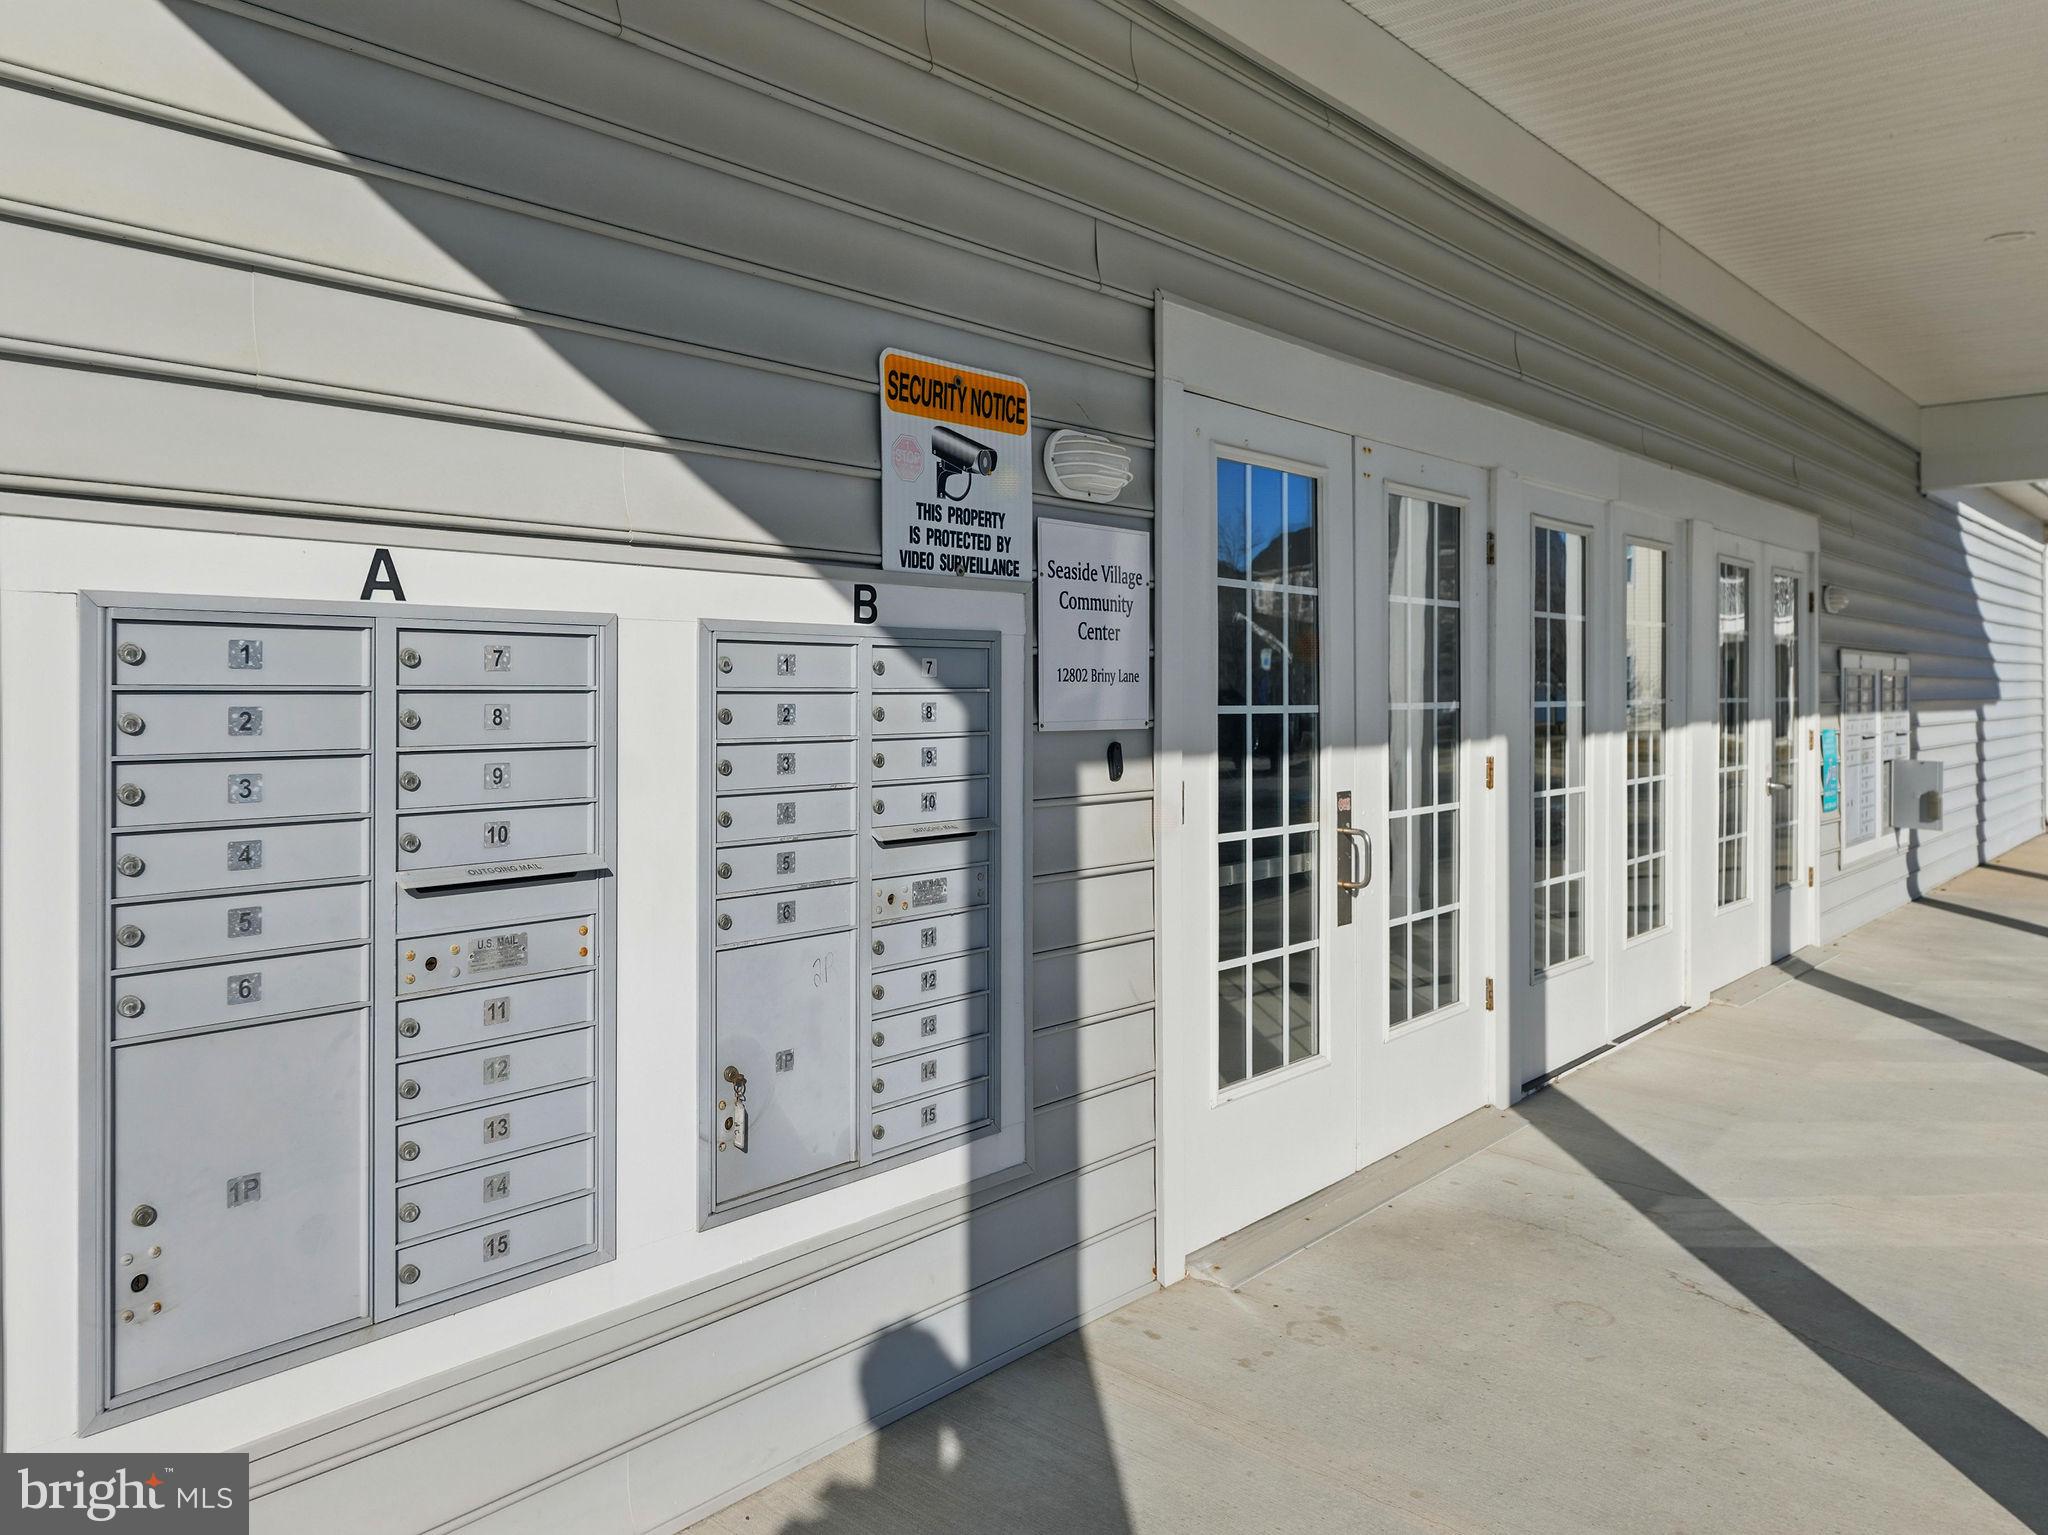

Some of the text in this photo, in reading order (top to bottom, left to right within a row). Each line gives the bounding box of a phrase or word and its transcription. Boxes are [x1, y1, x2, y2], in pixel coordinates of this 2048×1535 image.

[887, 369, 1027, 425] SECURITY NOTICE
[916, 501, 1006, 530] THIS PROPERTY
[909, 525, 1012, 554] IS PROTECTED BY
[899, 549, 1020, 578] VIDEO SURVEILLANCE
[360, 548, 407, 601] A
[1047, 559, 1143, 590] Seaside Village
[853, 584, 878, 624] B
[1059, 590, 1134, 618] Community
[1078, 621, 1120, 641] Center
[240, 644, 249, 664] 1
[493, 650, 503, 667] 7
[783, 657, 789, 672] 1
[926, 661, 932, 675] 7
[1057, 667, 1140, 686] 12802 Briny Lane
[239, 711, 252, 732] 2
[492, 708, 503, 726] 8
[783, 707, 790, 722] 2
[926, 705, 932, 719] 8
[783, 756, 790, 771] 3
[926, 750, 933, 764] 9
[493, 767, 503, 785] 9
[239, 779, 251, 798] 3
[923, 795, 935, 809] 10
[487, 825, 508, 844] 10
[238, 845, 252, 865] 4
[783, 856, 790, 871] 5
[467, 863, 543, 876] OUTGOING MAIL
[239, 912, 251, 932] 5
[783, 904, 791, 920] 6
[497, 935, 519, 947] MAIL
[923, 930, 934, 945] 11
[239, 979, 251, 999] 6
[488, 1001, 505, 1021] 11
[487, 1060, 508, 1080] 12
[922, 1108, 936, 1123] 15
[487, 1118, 508, 1139] 13
[230, 1178, 259, 1203] 1P
[487, 1176, 508, 1198] 14
[487, 1234, 508, 1257] 15
